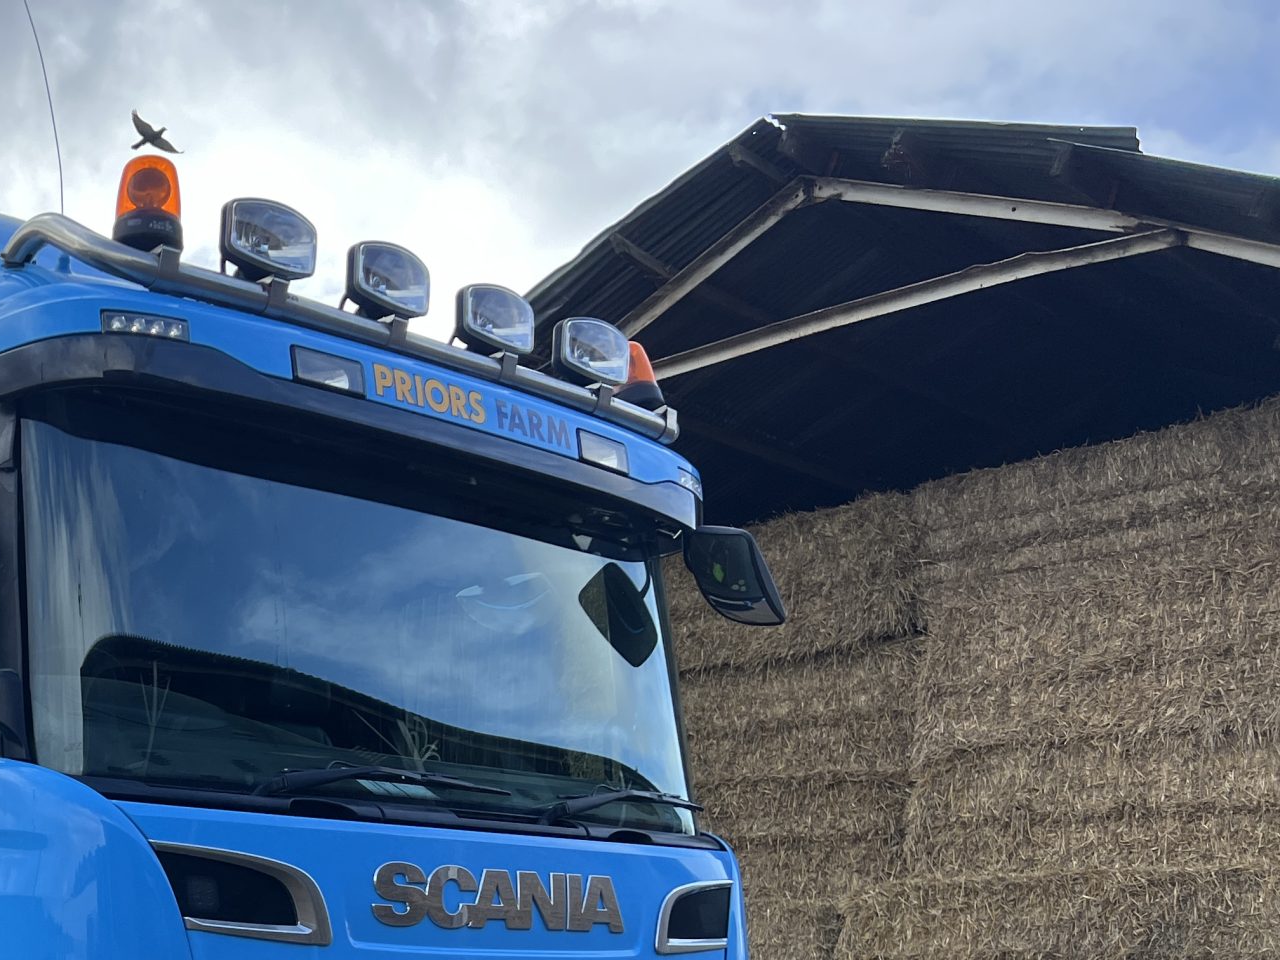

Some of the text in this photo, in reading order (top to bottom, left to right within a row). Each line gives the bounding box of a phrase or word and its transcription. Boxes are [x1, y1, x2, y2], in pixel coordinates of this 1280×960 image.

[373, 363, 572, 450] PRIORS FARM
[372, 861, 624, 933] SCANIA
